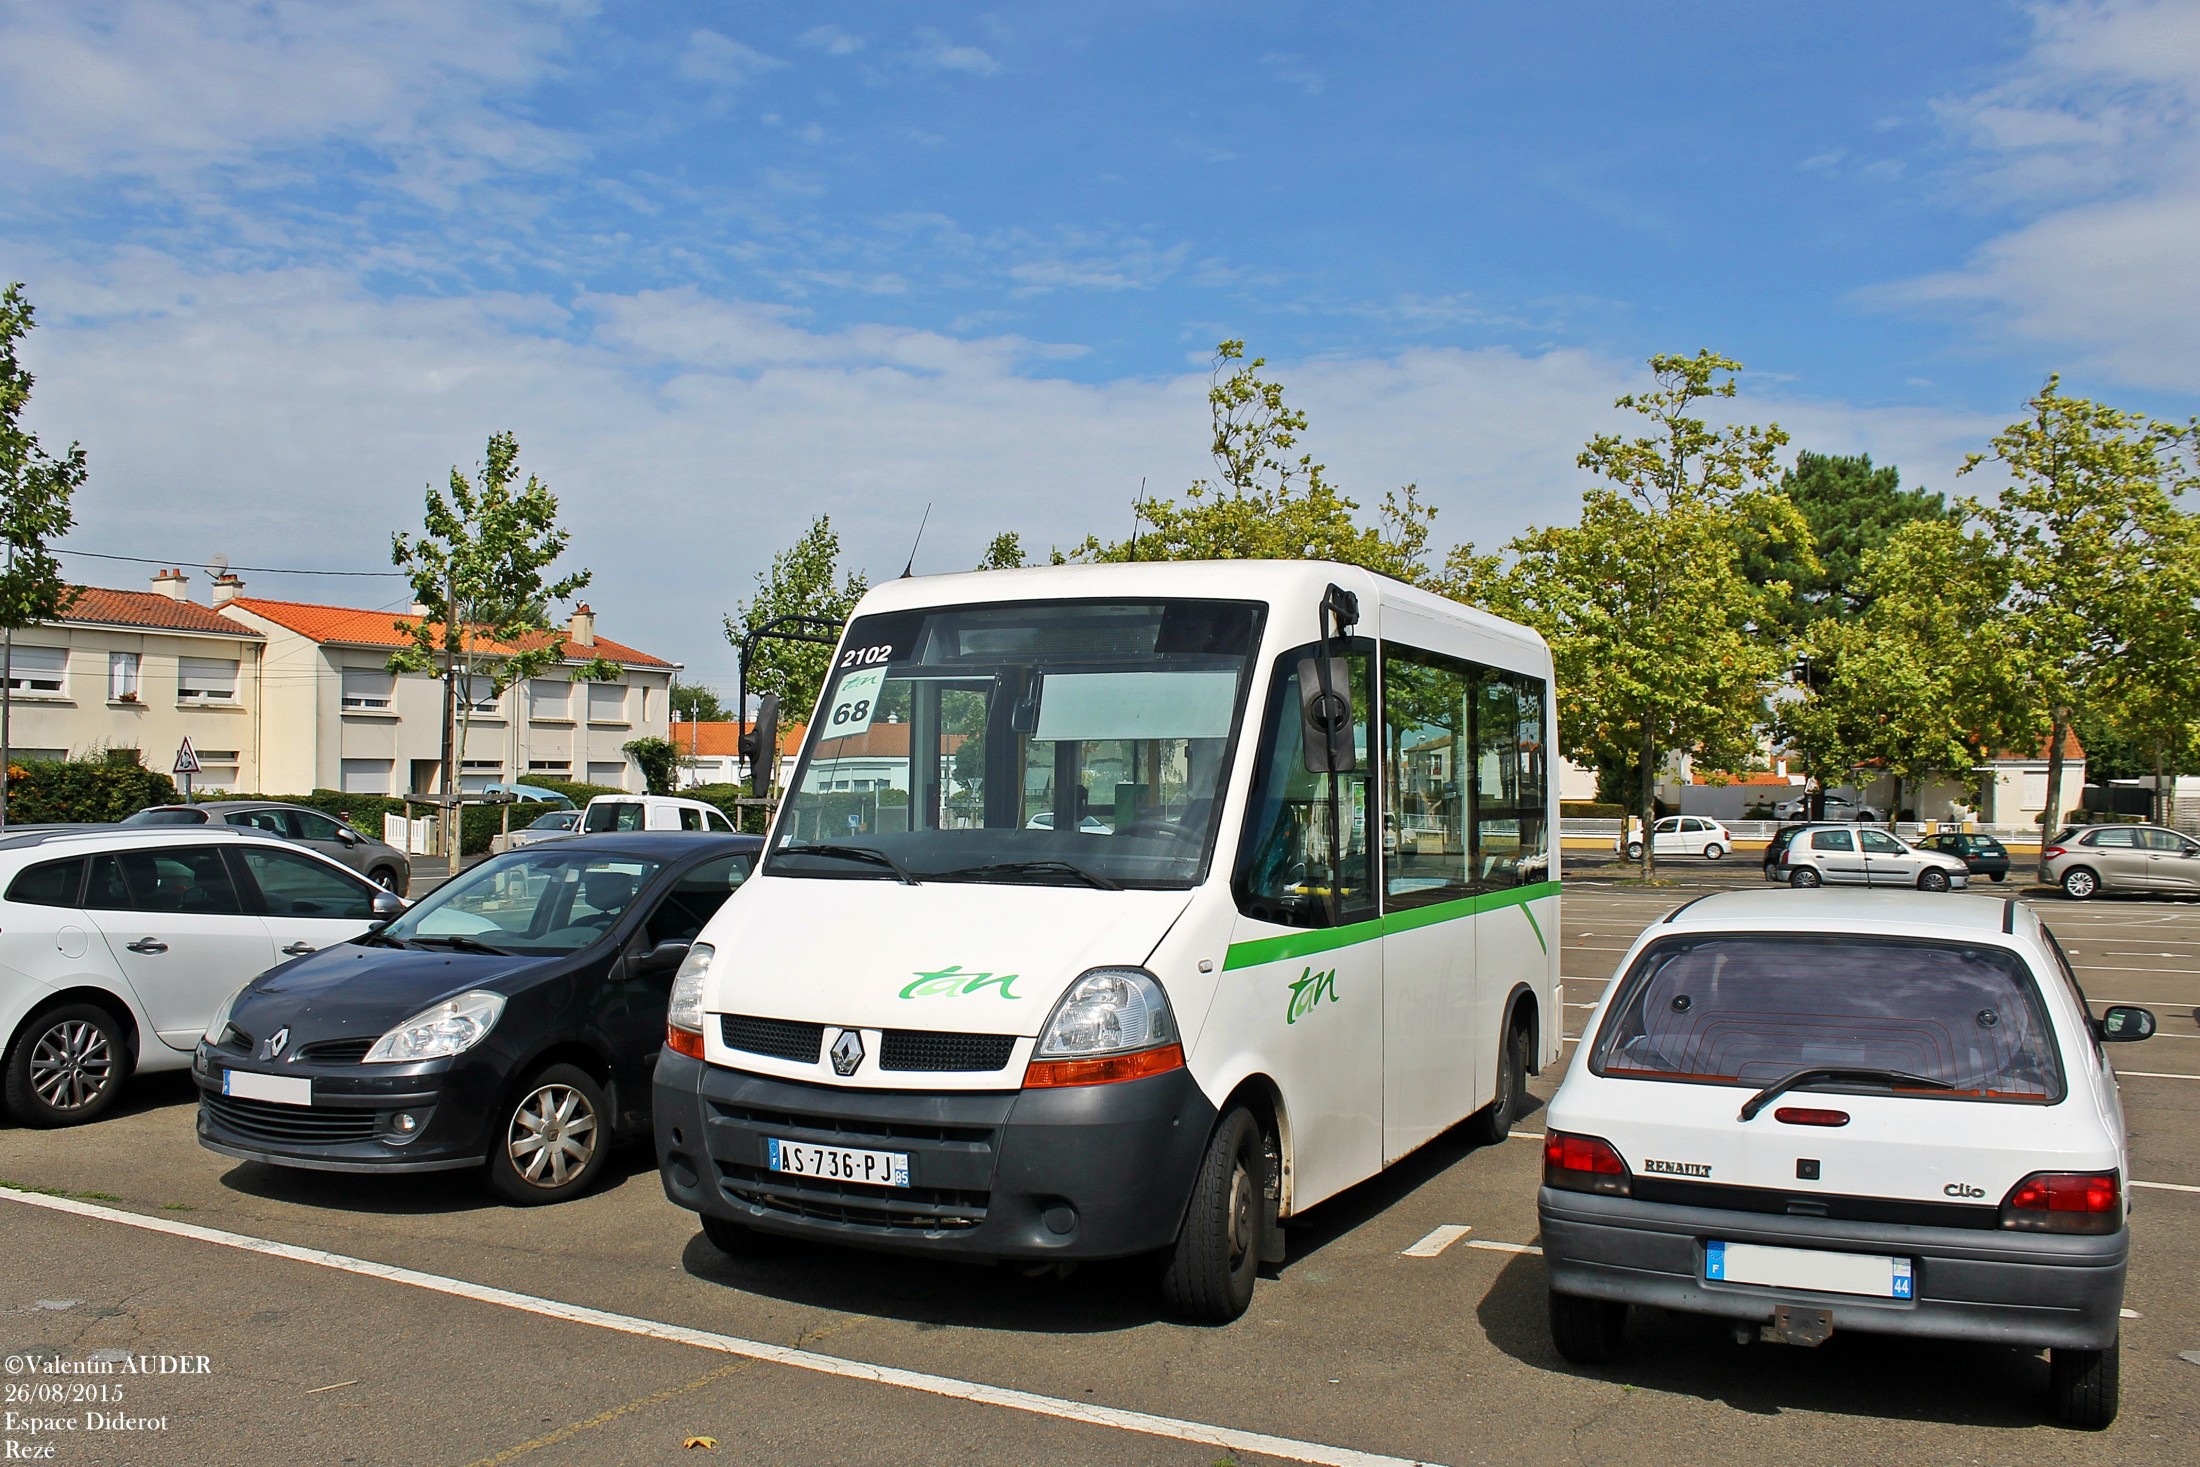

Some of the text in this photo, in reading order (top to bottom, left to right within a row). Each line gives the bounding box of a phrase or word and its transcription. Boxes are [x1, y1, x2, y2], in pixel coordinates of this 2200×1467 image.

[840, 644, 893, 668] 2102
[833, 699, 870, 726] 68
[898, 965, 1023, 1000] tan
[1287, 966, 1340, 1025] tan
[772, 1157, 777, 1166] F
[895, 1170, 909, 1184] 85
[1644, 1159, 1712, 1178] RENAULT
[1943, 1182, 1986, 1198] Clio
[1712, 1263, 1909, 1294] F 44
